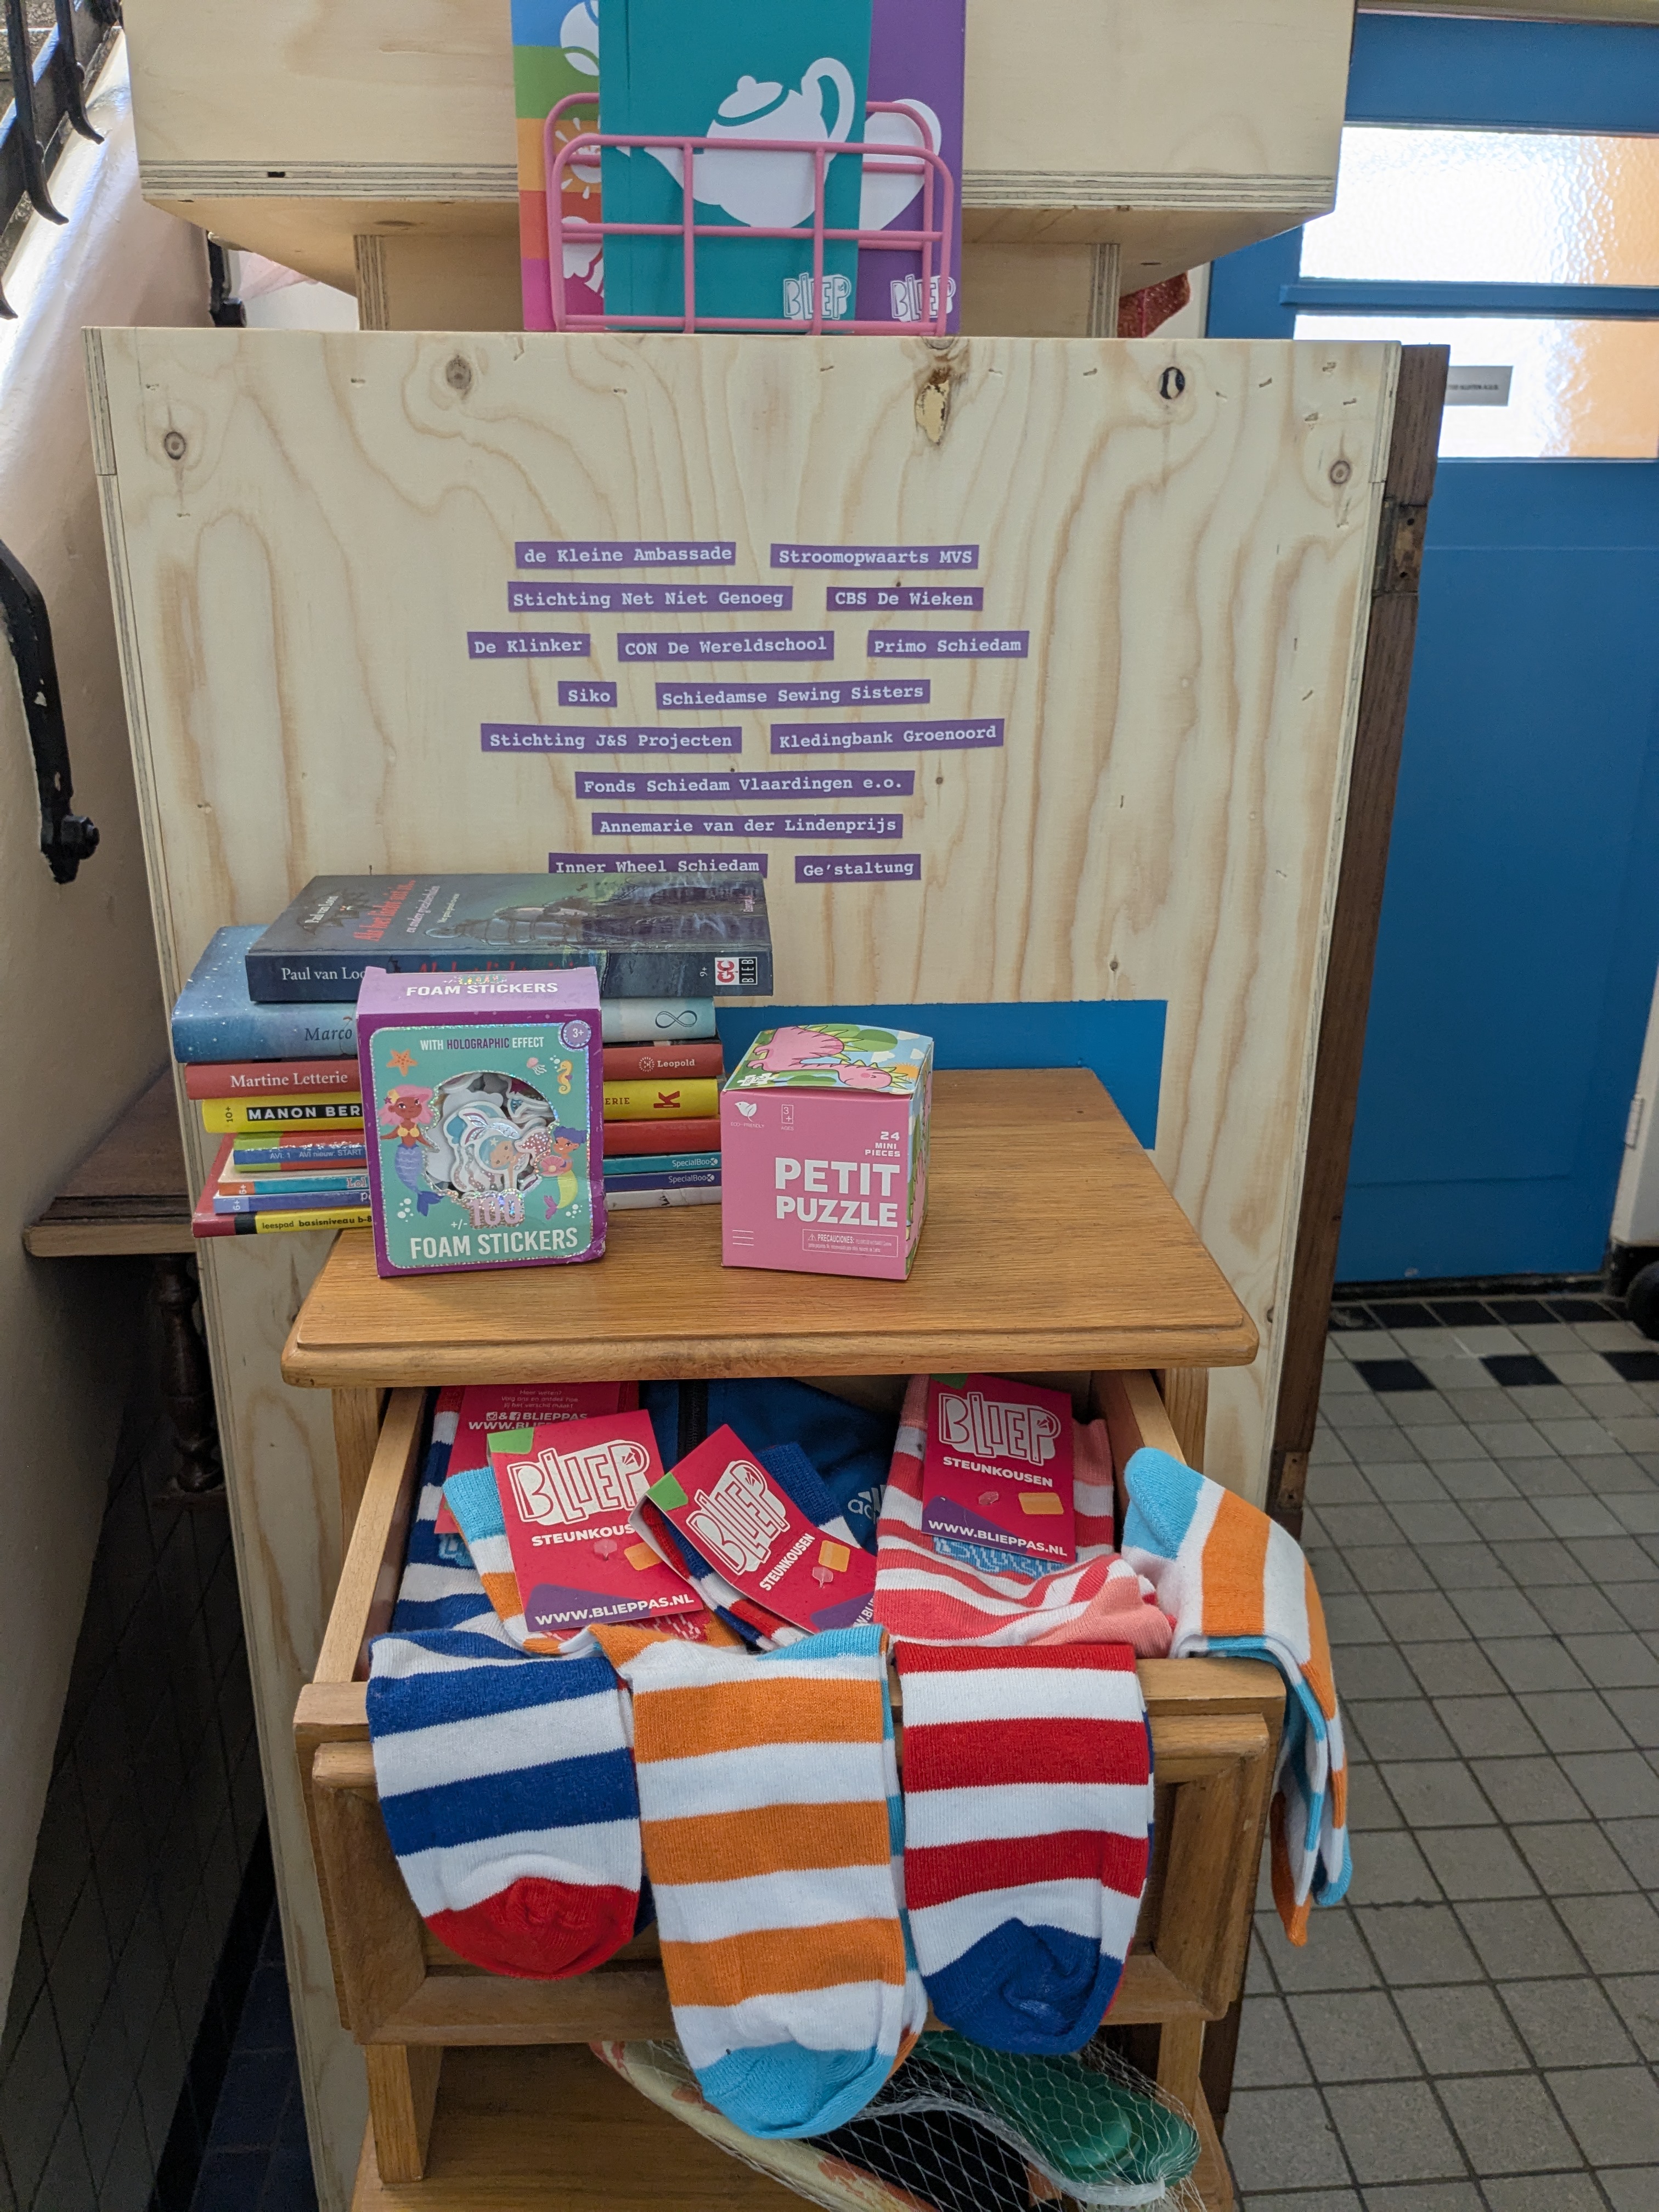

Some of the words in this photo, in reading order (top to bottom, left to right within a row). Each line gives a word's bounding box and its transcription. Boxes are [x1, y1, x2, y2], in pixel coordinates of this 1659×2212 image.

[524, 549, 546, 562] de
[557, 549, 623, 562] Kleine
[634, 547, 732, 561] Ambassade
[779, 550, 929, 566] Stroomopwaarts
[939, 551, 972, 563] MVS
[514, 593, 611, 608] Stichting
[622, 592, 654, 605] Net
[665, 592, 708, 605] Niet
[719, 592, 783, 607] Genoeg
[835, 592, 867, 605] CBS
[878, 592, 899, 605] De
[909, 592, 973, 606] Wieken
[475, 641, 496, 653] De
[507, 640, 582, 653] Klinker
[625, 642, 657, 655] CON
[668, 642, 689, 654] De
[699, 637, 827, 653] Wereldschool
[874, 641, 927, 653] Primo
[937, 639, 1022, 652] Schiedam
[568, 689, 611, 703] Siko
[662, 691, 767, 706] Schiedamse
[778, 687, 840, 703] Sewing
[851, 685, 923, 699] Sisters
[490, 734, 585, 749] Stichting
[596, 734, 627, 747] J&S
[638, 735, 732, 749] Projecten
[780, 731, 893, 748] Kledingbank
[903, 725, 996, 742] Groenoord
[584, 780, 635, 793] Fonds
[647, 778, 730, 792] Schiedam
[740, 776, 853, 792] Vlaardingen
[863, 777, 902, 789] e.o.
[600, 821, 693, 832] Annemarie
[703, 821, 734, 832] van
[744, 820, 774, 832] der
[785, 819, 896, 833] Lindenprijs
[556, 862, 606, 873] Inner
[616, 860, 667, 872] Wheel
[678, 858, 759, 872] Schiedam
[281, 968, 311, 980] Paul
[314, 970, 337, 980] van
[342, 967, 365, 979] Loo
[741, 960, 754, 983] BIEB
[407, 985, 460, 996] FOAM
[467, 983, 558, 994] STICKERS
[304, 1028, 353, 1041] Marco
[573, 1027, 585, 1039] 3+
[420, 1040, 444, 1051] WITH
[447, 1037, 510, 1049] HOLOGRAPHIC
[512, 1037, 544, 1048] EFFECT
[657, 1059, 695, 1068] Leopold
[230, 1074, 289, 1088] Martine
[293, 1071, 348, 1085] Letterie
[249, 1107, 317, 1120] MANON
[325, 1105, 360, 1116] BER
[881, 1132, 900, 1141] 24
[775, 1158, 900, 1197] PETIT
[233, 1200, 241, 1210] 6+
[466, 1194, 521, 1226] 100
[777, 1196, 898, 1227] PUZZLE
[262, 1221, 294, 1231] leespad
[299, 1218, 355, 1227] basisniveau
[411, 1234, 471, 1260] FOAM
[478, 1227, 578, 1254] STICKERS
[523, 1412, 588, 1420] BLIEPPAS
[939, 1392, 1062, 1466] BLIEP
[943, 1457, 1052, 1487] STEUNKOUSEN
[507, 1439, 650, 1525] BLIEP
[686, 1460, 791, 1575] BLIEP
[532, 1523, 636, 1547] STEUNKOUS
[928, 1520, 1068, 1557] WWW.BLIEPPAS.NL
[759, 1533, 815, 1591] STEUNKOUSEN
[535, 1594, 694, 1625] WWW.BLIEPPAS.NL
